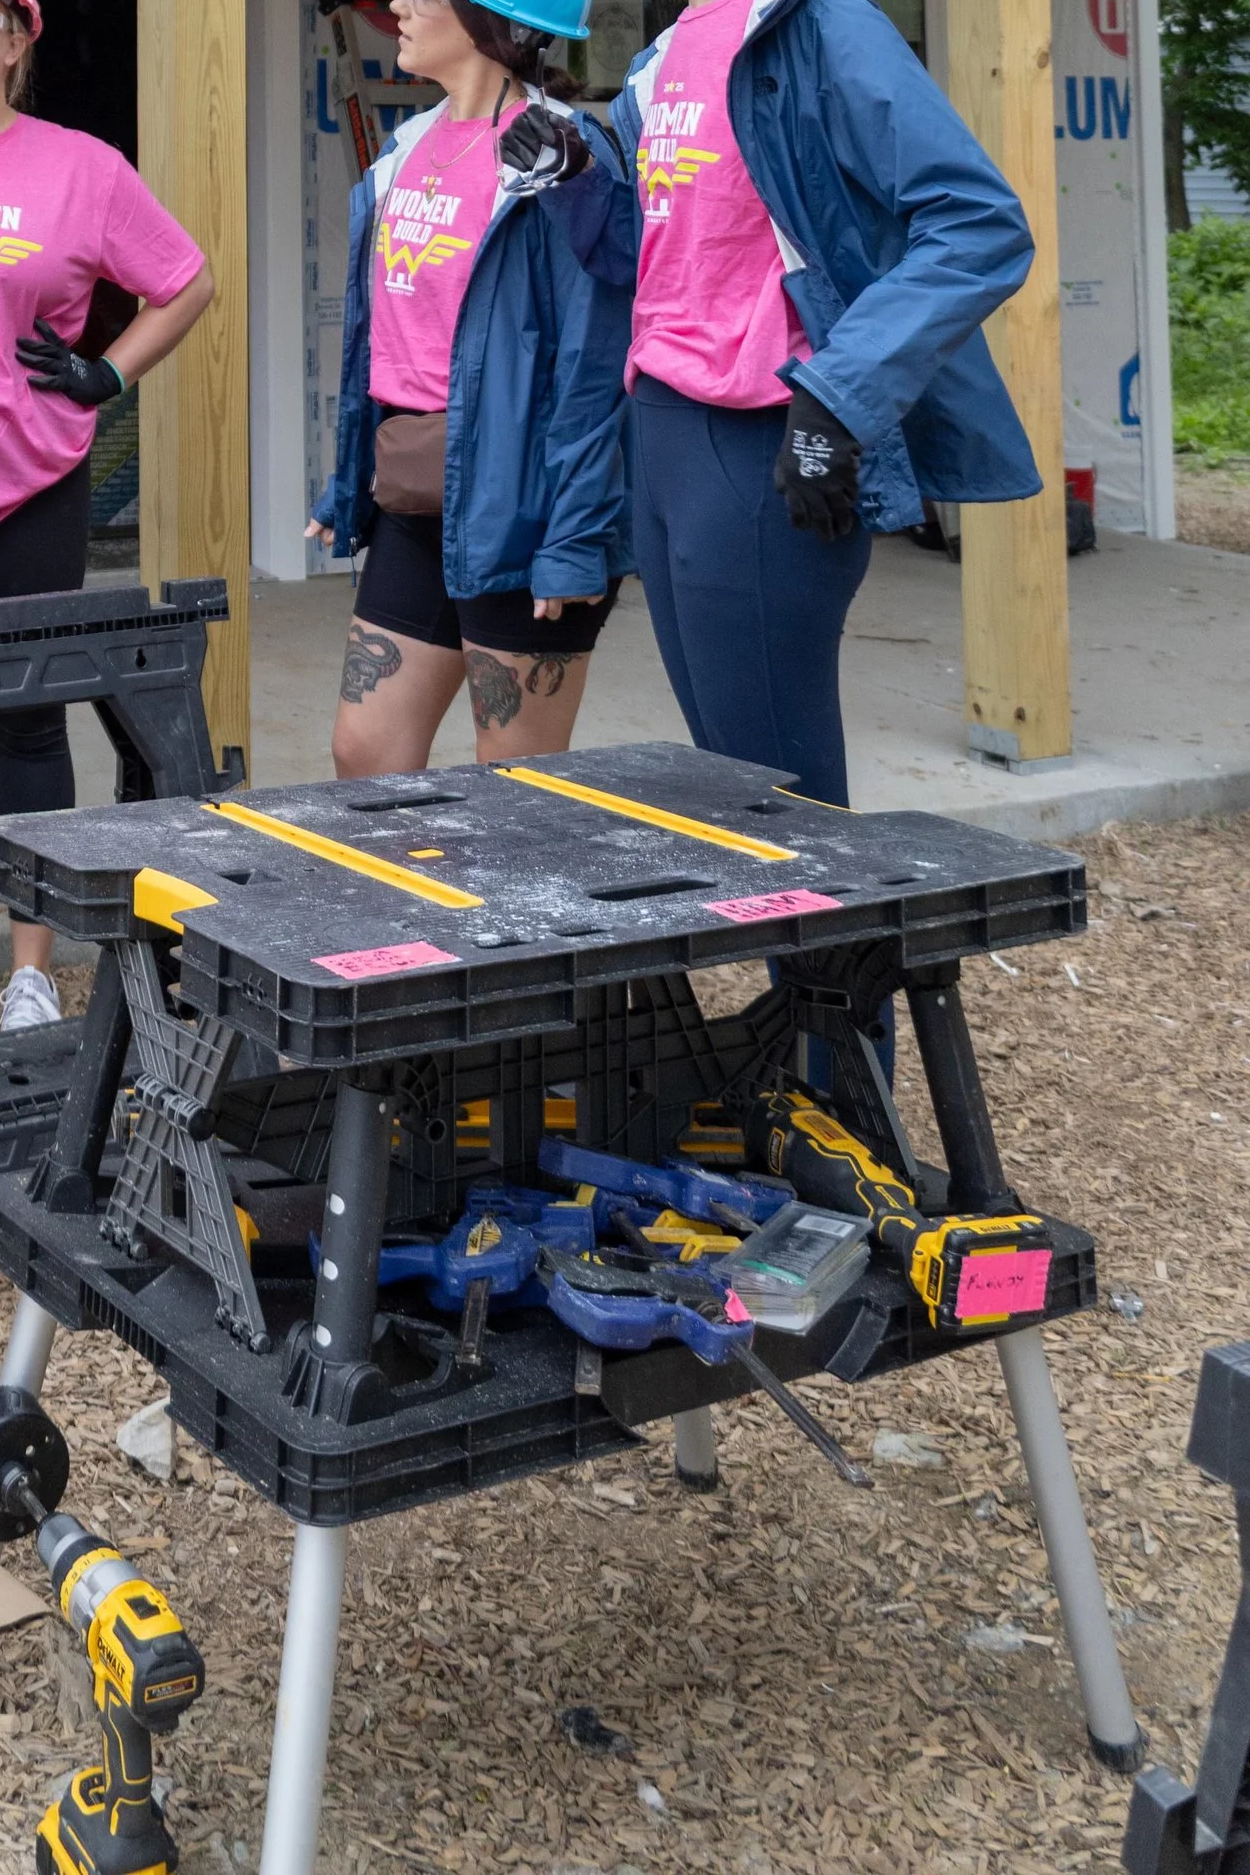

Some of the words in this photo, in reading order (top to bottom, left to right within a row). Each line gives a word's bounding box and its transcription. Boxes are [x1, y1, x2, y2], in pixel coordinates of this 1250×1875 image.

[388, 187, 463, 228] WOMEN
[392, 218, 433, 245] BUILD
[97, 1636, 126, 1679] DEWALT
